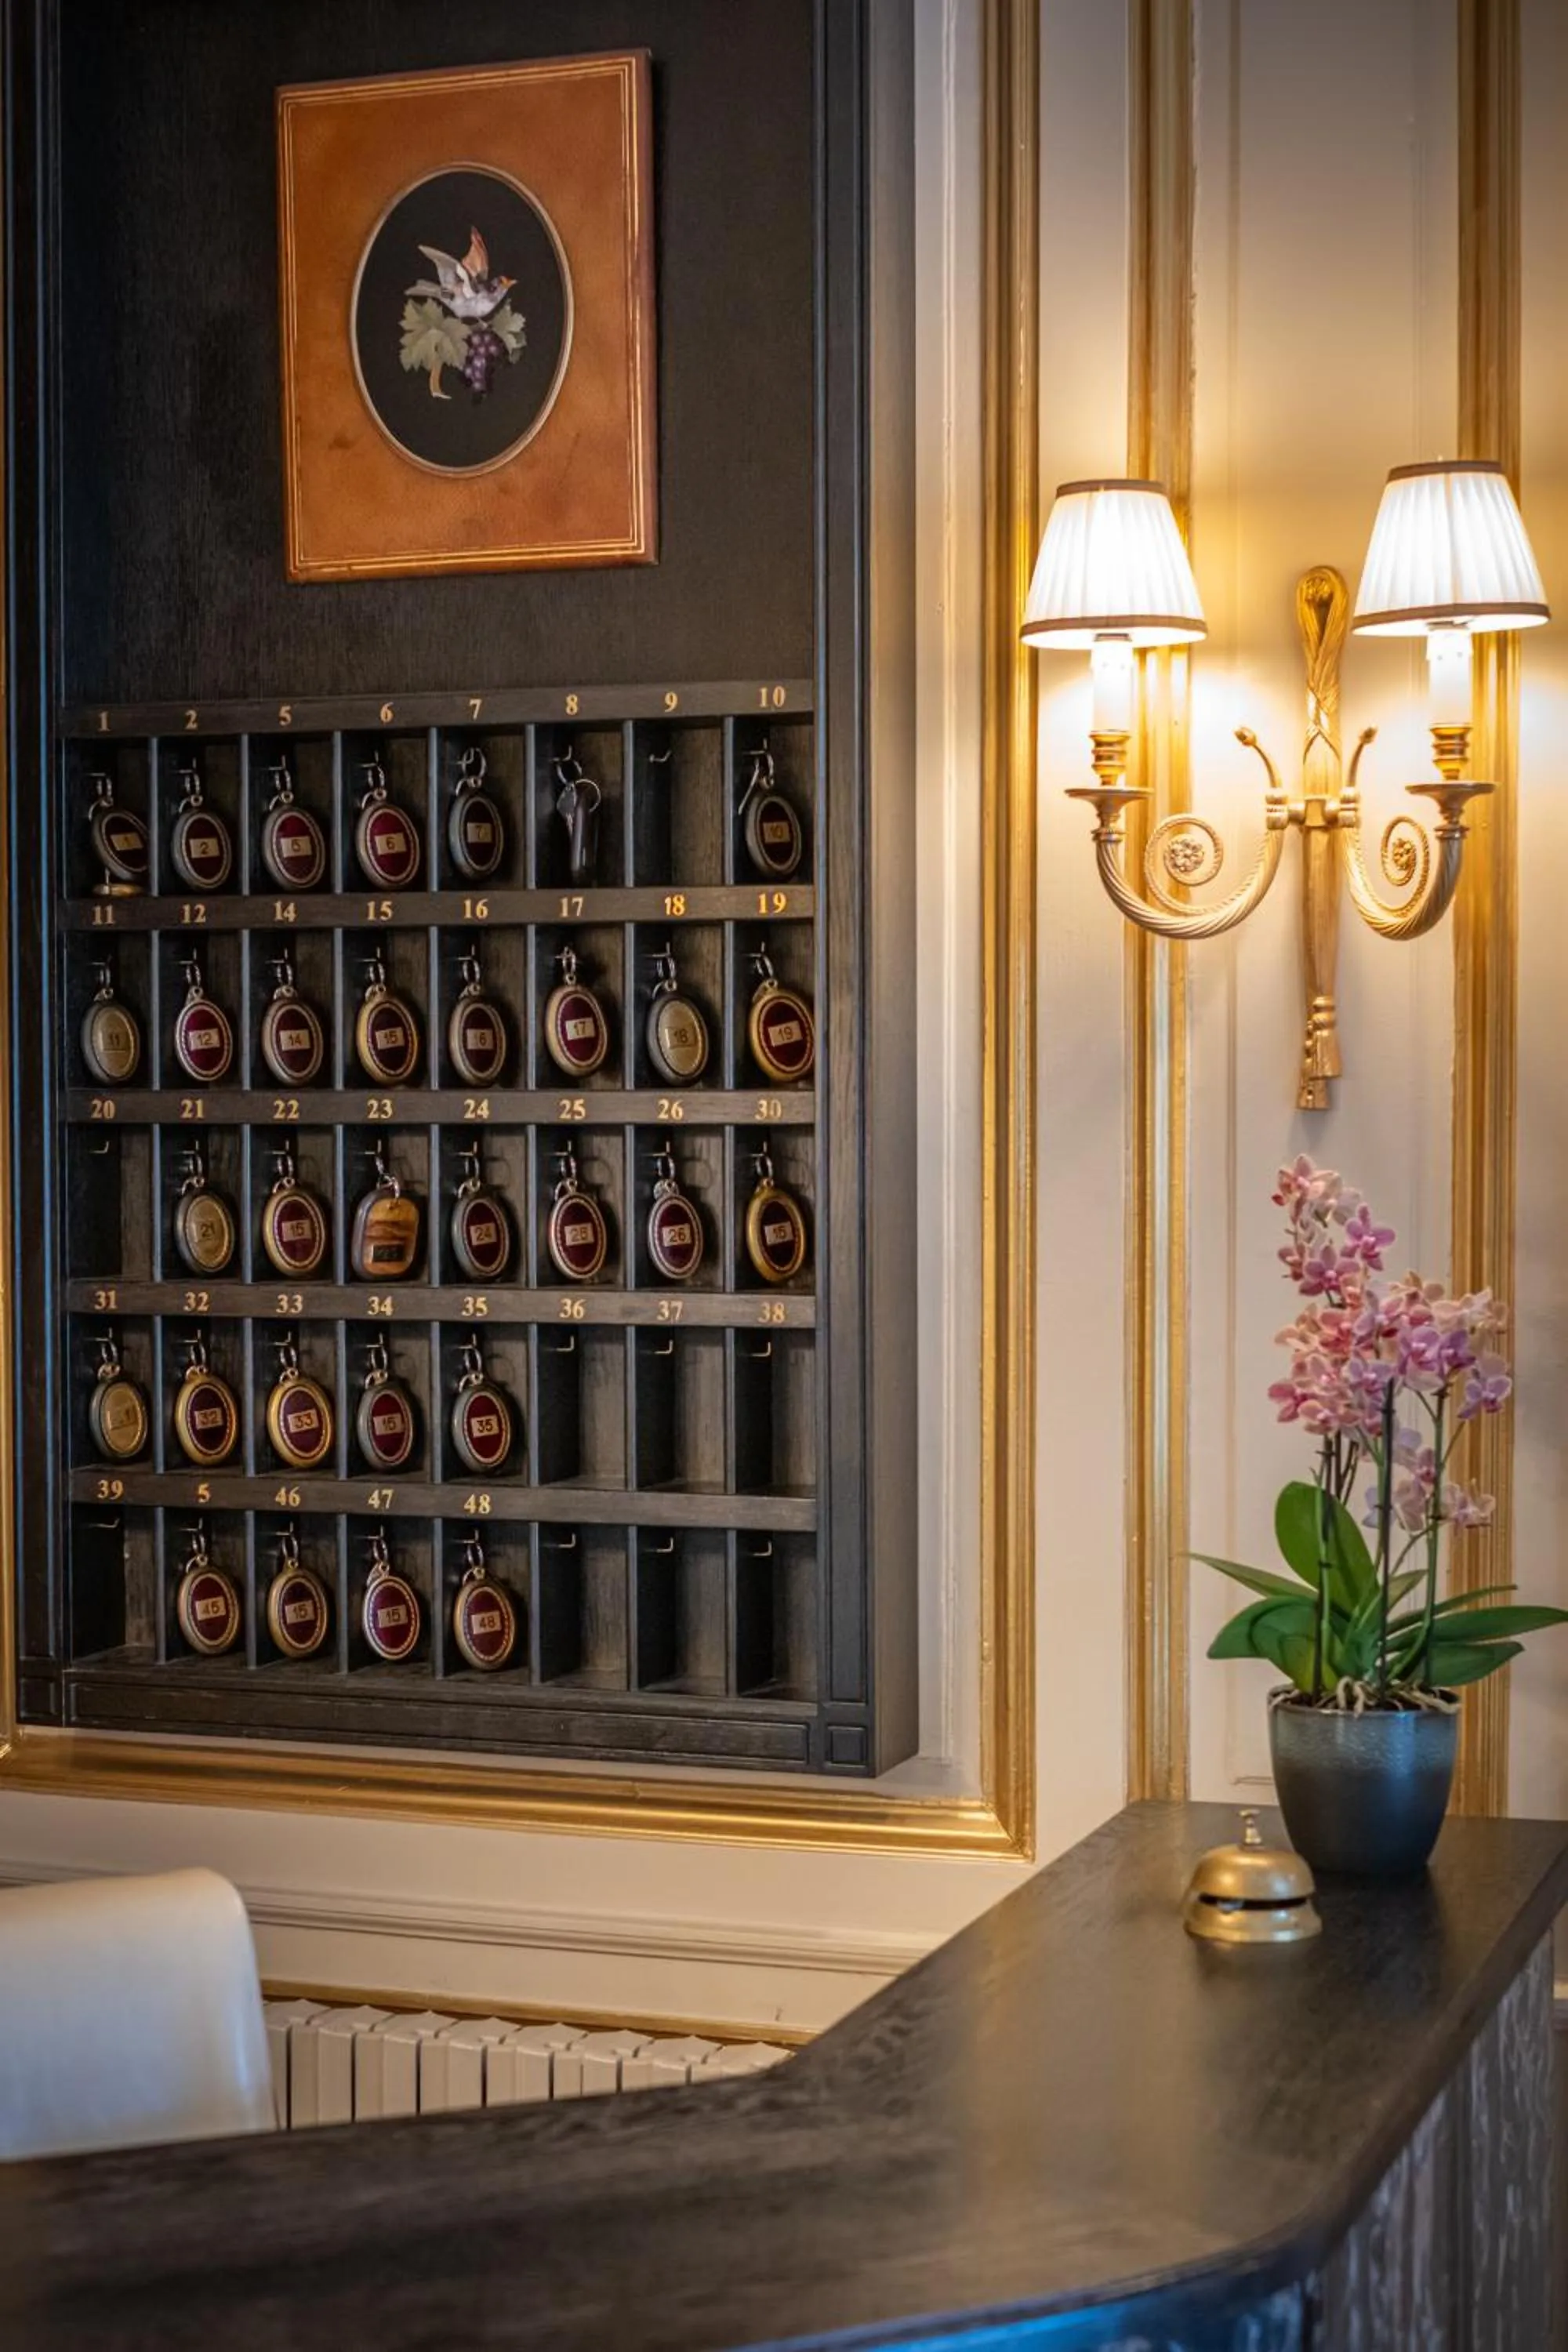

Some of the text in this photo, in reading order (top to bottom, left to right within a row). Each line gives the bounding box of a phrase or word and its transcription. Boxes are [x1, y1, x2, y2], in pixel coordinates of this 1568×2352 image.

[566, 695, 578, 715] 8
[665, 692, 677, 711] 9
[759, 686, 786, 707] 10
[279, 706, 291, 725] 5
[380, 702, 393, 723] 6
[469, 699, 482, 719] 7
[99, 711, 109, 731] 1
[186, 710, 198, 729] 2
[200, 841, 209, 855] 2
[274, 901, 296, 922] 14
[368, 901, 392, 920] 15
[464, 899, 488, 919] 16
[561, 896, 583, 917] 17
[665, 895, 685, 916] 18
[759, 893, 786, 913] 19
[93, 905, 114, 924] 11
[183, 903, 205, 923] 12
[573, 1021, 586, 1036] 17
[778, 1026, 793, 1041] 19
[198, 1032, 213, 1046] 12
[289, 1033, 302, 1046] 14
[92, 1098, 116, 1120] 20
[182, 1099, 204, 1118] 21
[274, 1099, 299, 1119] 22
[368, 1098, 393, 1119] 23
[464, 1099, 489, 1119] 24
[560, 1098, 586, 1120] 25
[658, 1098, 684, 1120] 26
[755, 1098, 782, 1120] 30
[475, 1226, 492, 1241] 24
[95, 1290, 117, 1309] 31
[184, 1292, 209, 1311] 32
[276, 1294, 303, 1313] 33
[368, 1296, 394, 1316] 34
[462, 1297, 488, 1316] 35
[560, 1298, 585, 1319] 36
[658, 1300, 684, 1322] 37
[759, 1302, 786, 1323] 38
[200, 1410, 217, 1425] 32
[295, 1412, 313, 1428] 33
[477, 1419, 494, 1432] 35
[98, 1480, 124, 1499] 39
[198, 1483, 210, 1502] 5
[275, 1486, 301, 1507] 46
[368, 1489, 394, 1508] 47
[464, 1494, 491, 1513] 48
[480, 1616, 495, 1629] 48
